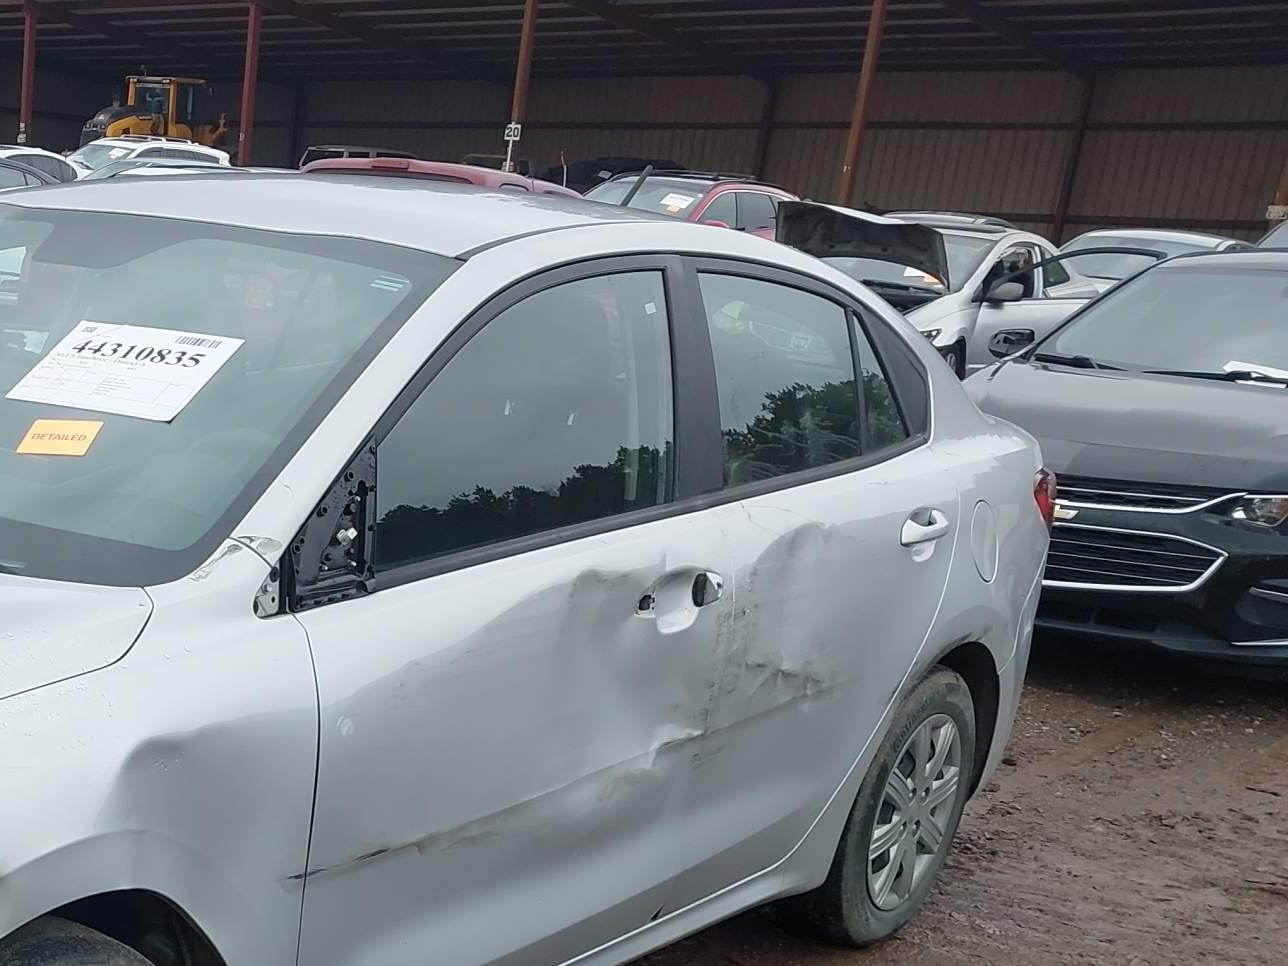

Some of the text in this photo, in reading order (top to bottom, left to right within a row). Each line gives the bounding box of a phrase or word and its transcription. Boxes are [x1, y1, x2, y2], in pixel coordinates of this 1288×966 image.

[506, 127, 520, 138] 20
[72, 339, 207, 369] 44310835
[31, 432, 87, 442] DETAILED
